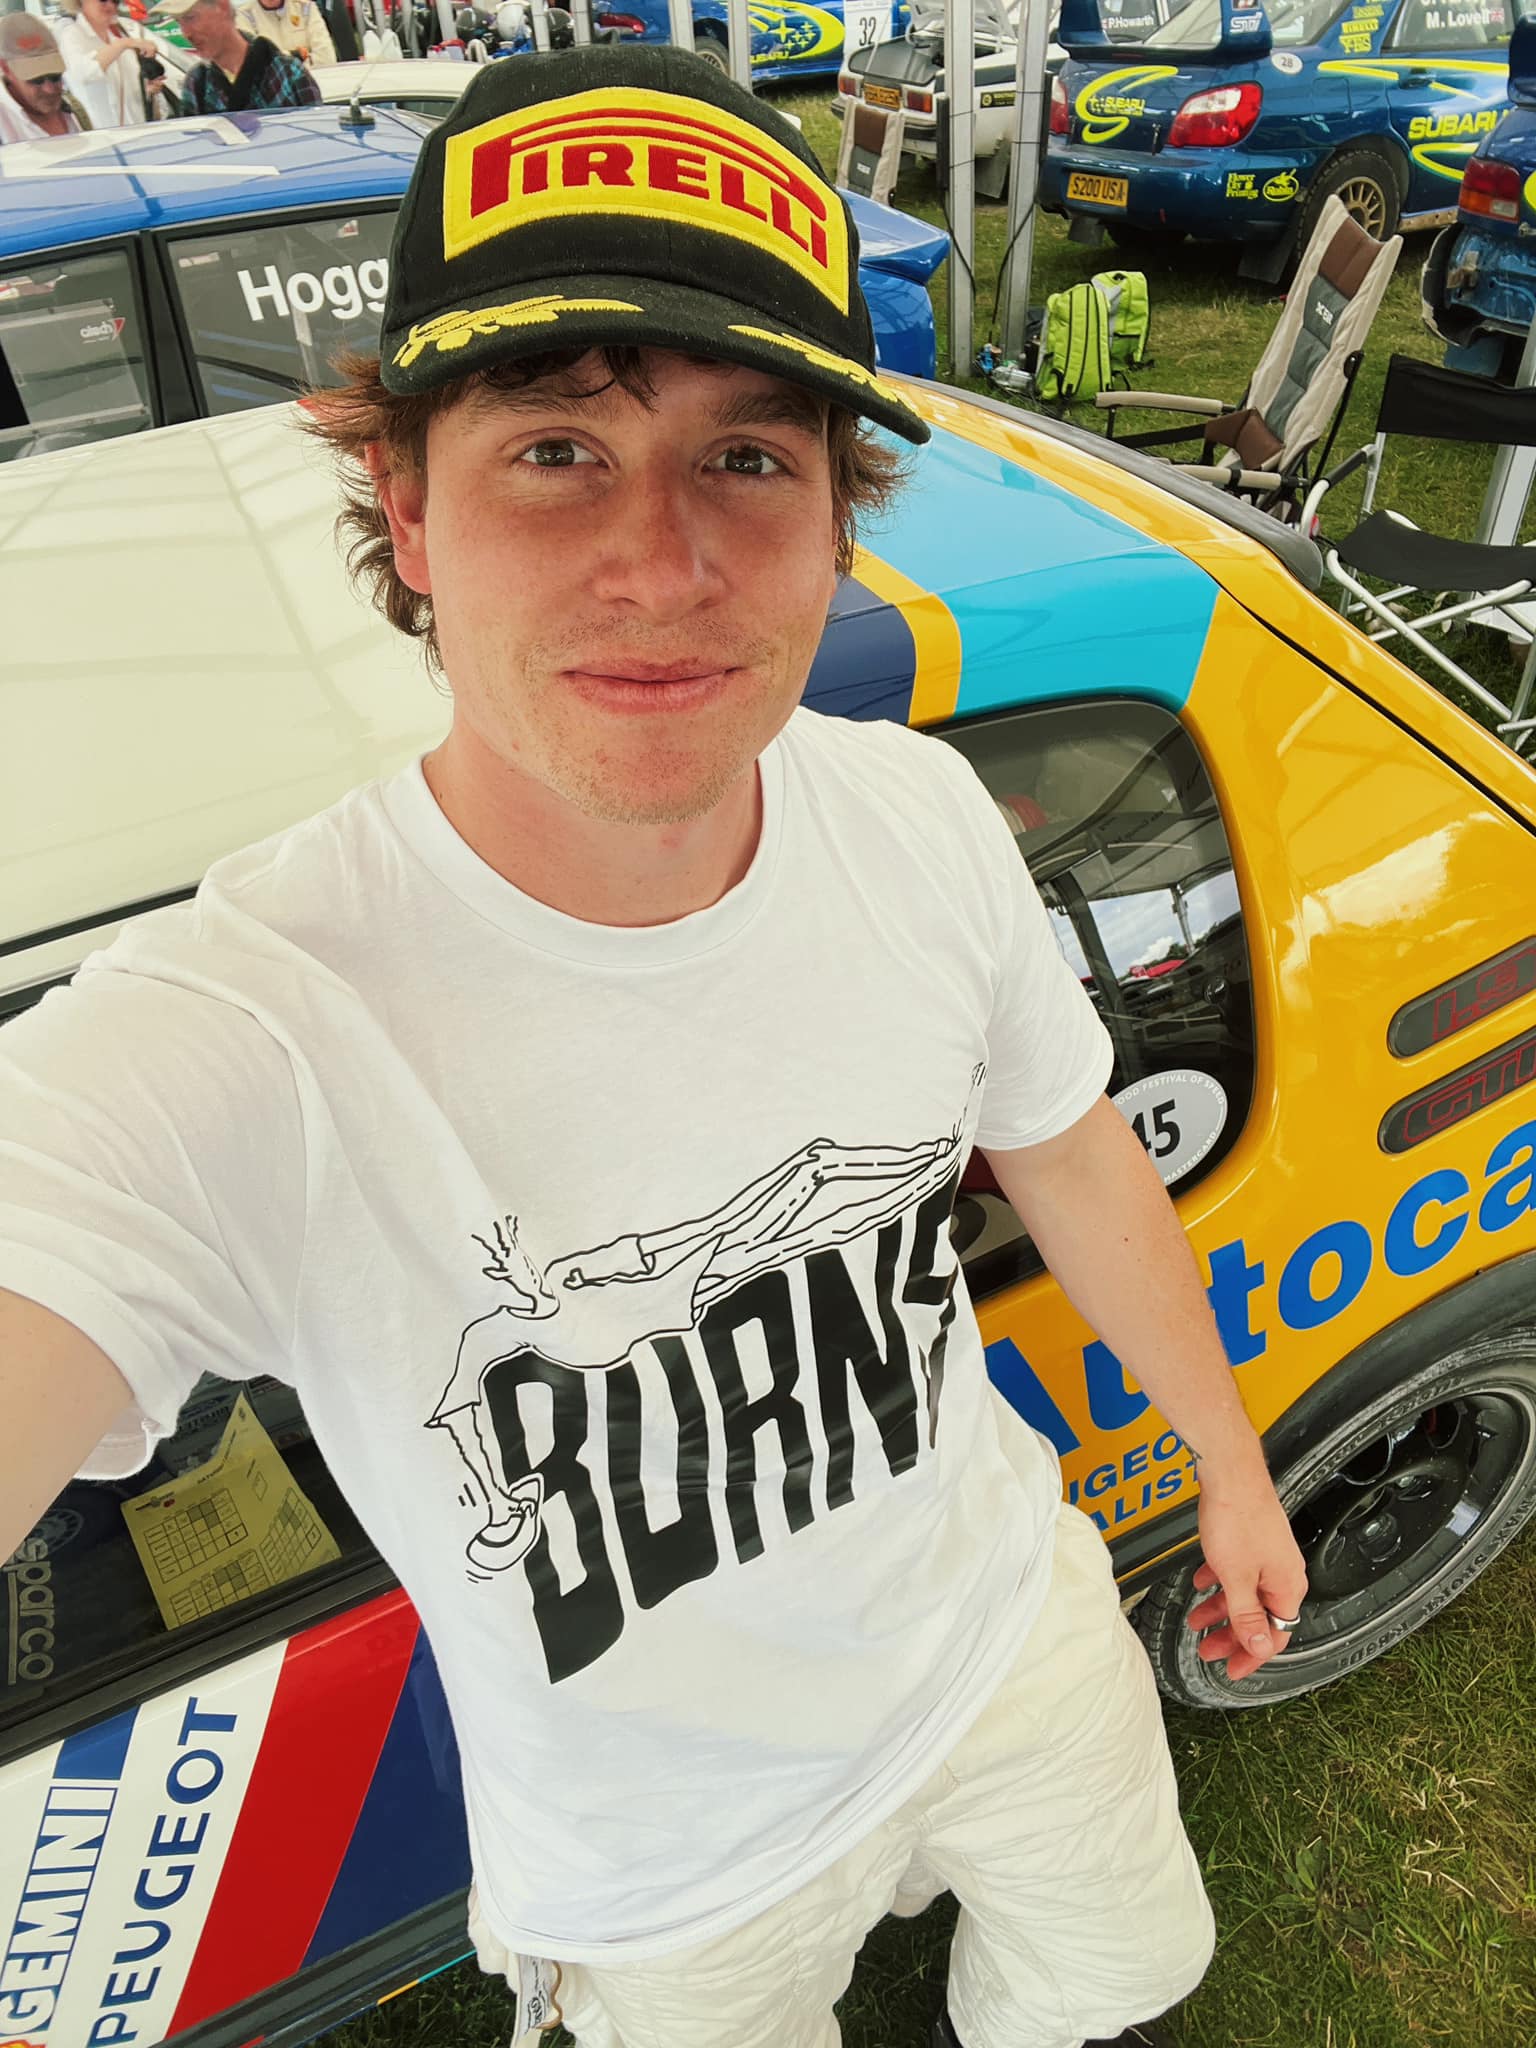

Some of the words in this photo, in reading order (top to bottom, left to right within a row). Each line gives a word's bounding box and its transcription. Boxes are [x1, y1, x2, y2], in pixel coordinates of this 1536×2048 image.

[859, 17, 877, 46] 32
[470, 108, 828, 269] PIRELLI
[1073, 176, 1101, 198] S200
[1102, 180, 1126, 200] USA
[1142, 1074, 1187, 1092] FESTIVAL
[87, 1697, 238, 2048] PEUGEOT
